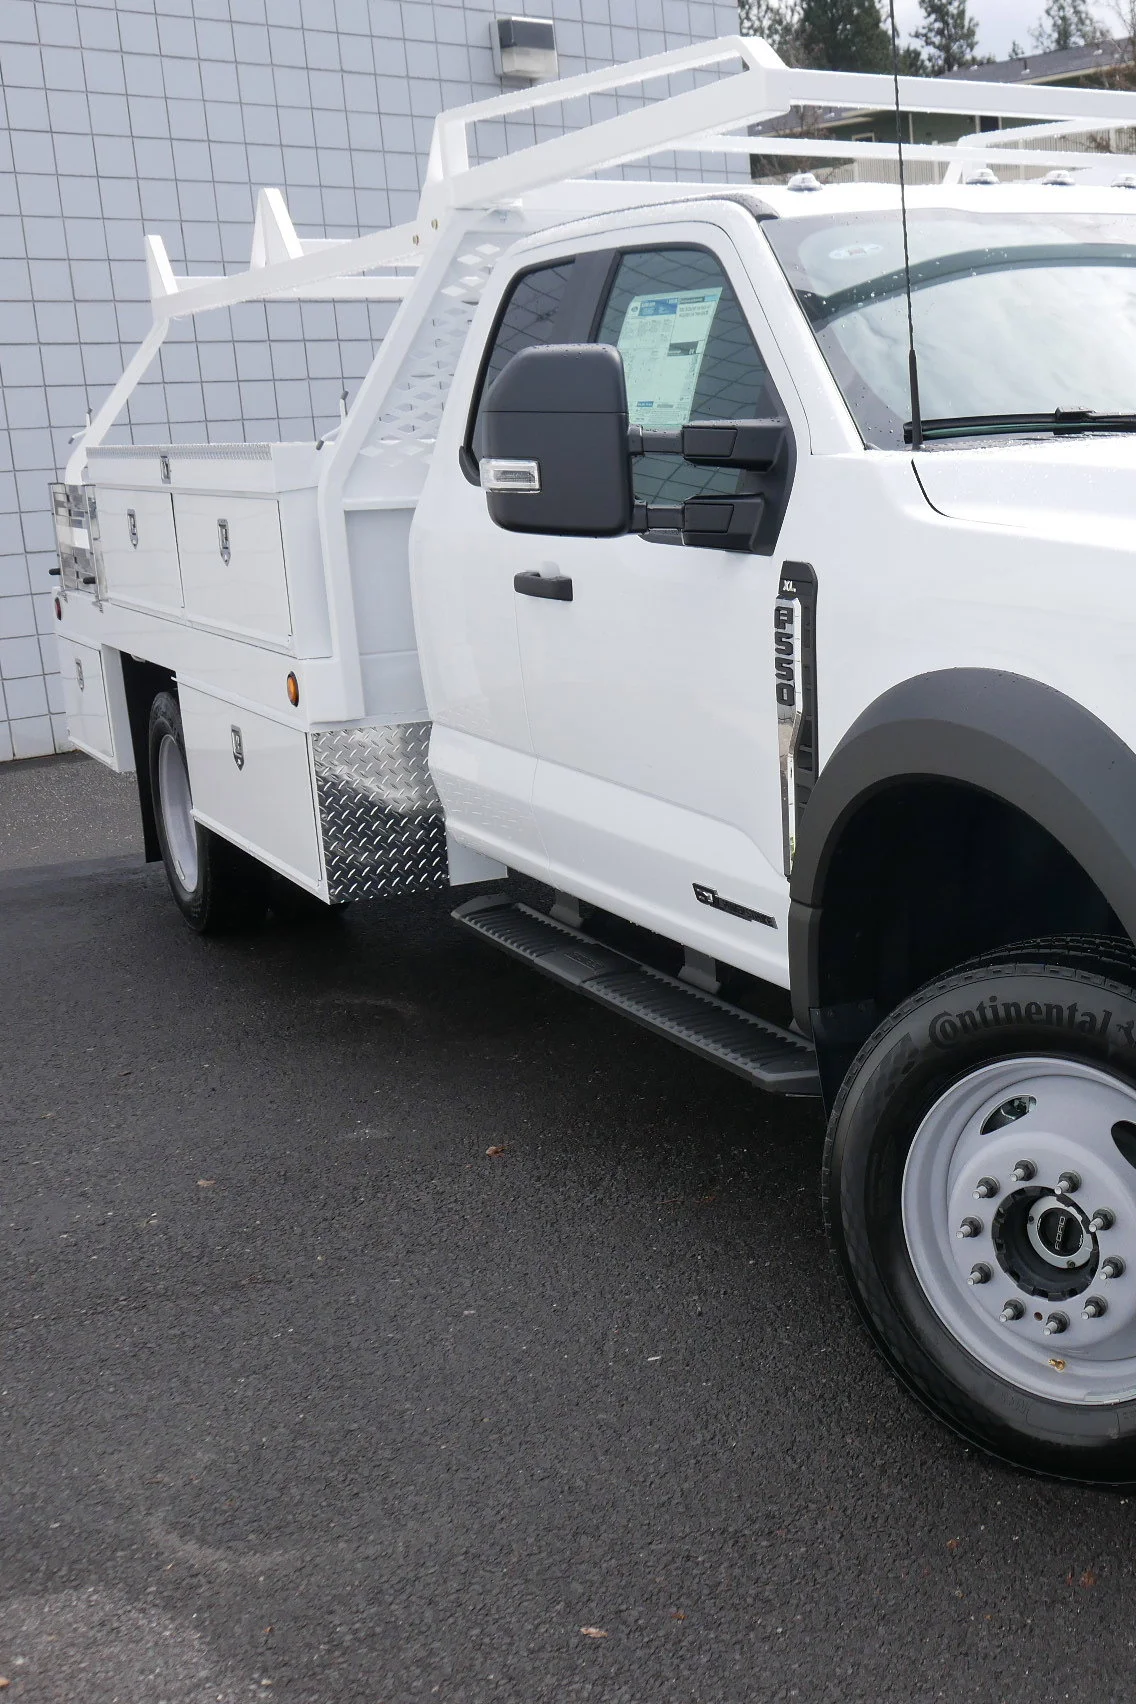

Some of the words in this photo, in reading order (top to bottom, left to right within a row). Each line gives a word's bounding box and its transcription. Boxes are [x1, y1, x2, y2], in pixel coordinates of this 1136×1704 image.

[782, 580, 796, 592] XL
[774, 606, 796, 707] F550
[928, 995, 1112, 1050] Continental
[1054, 1216, 1066, 1251] FORD
